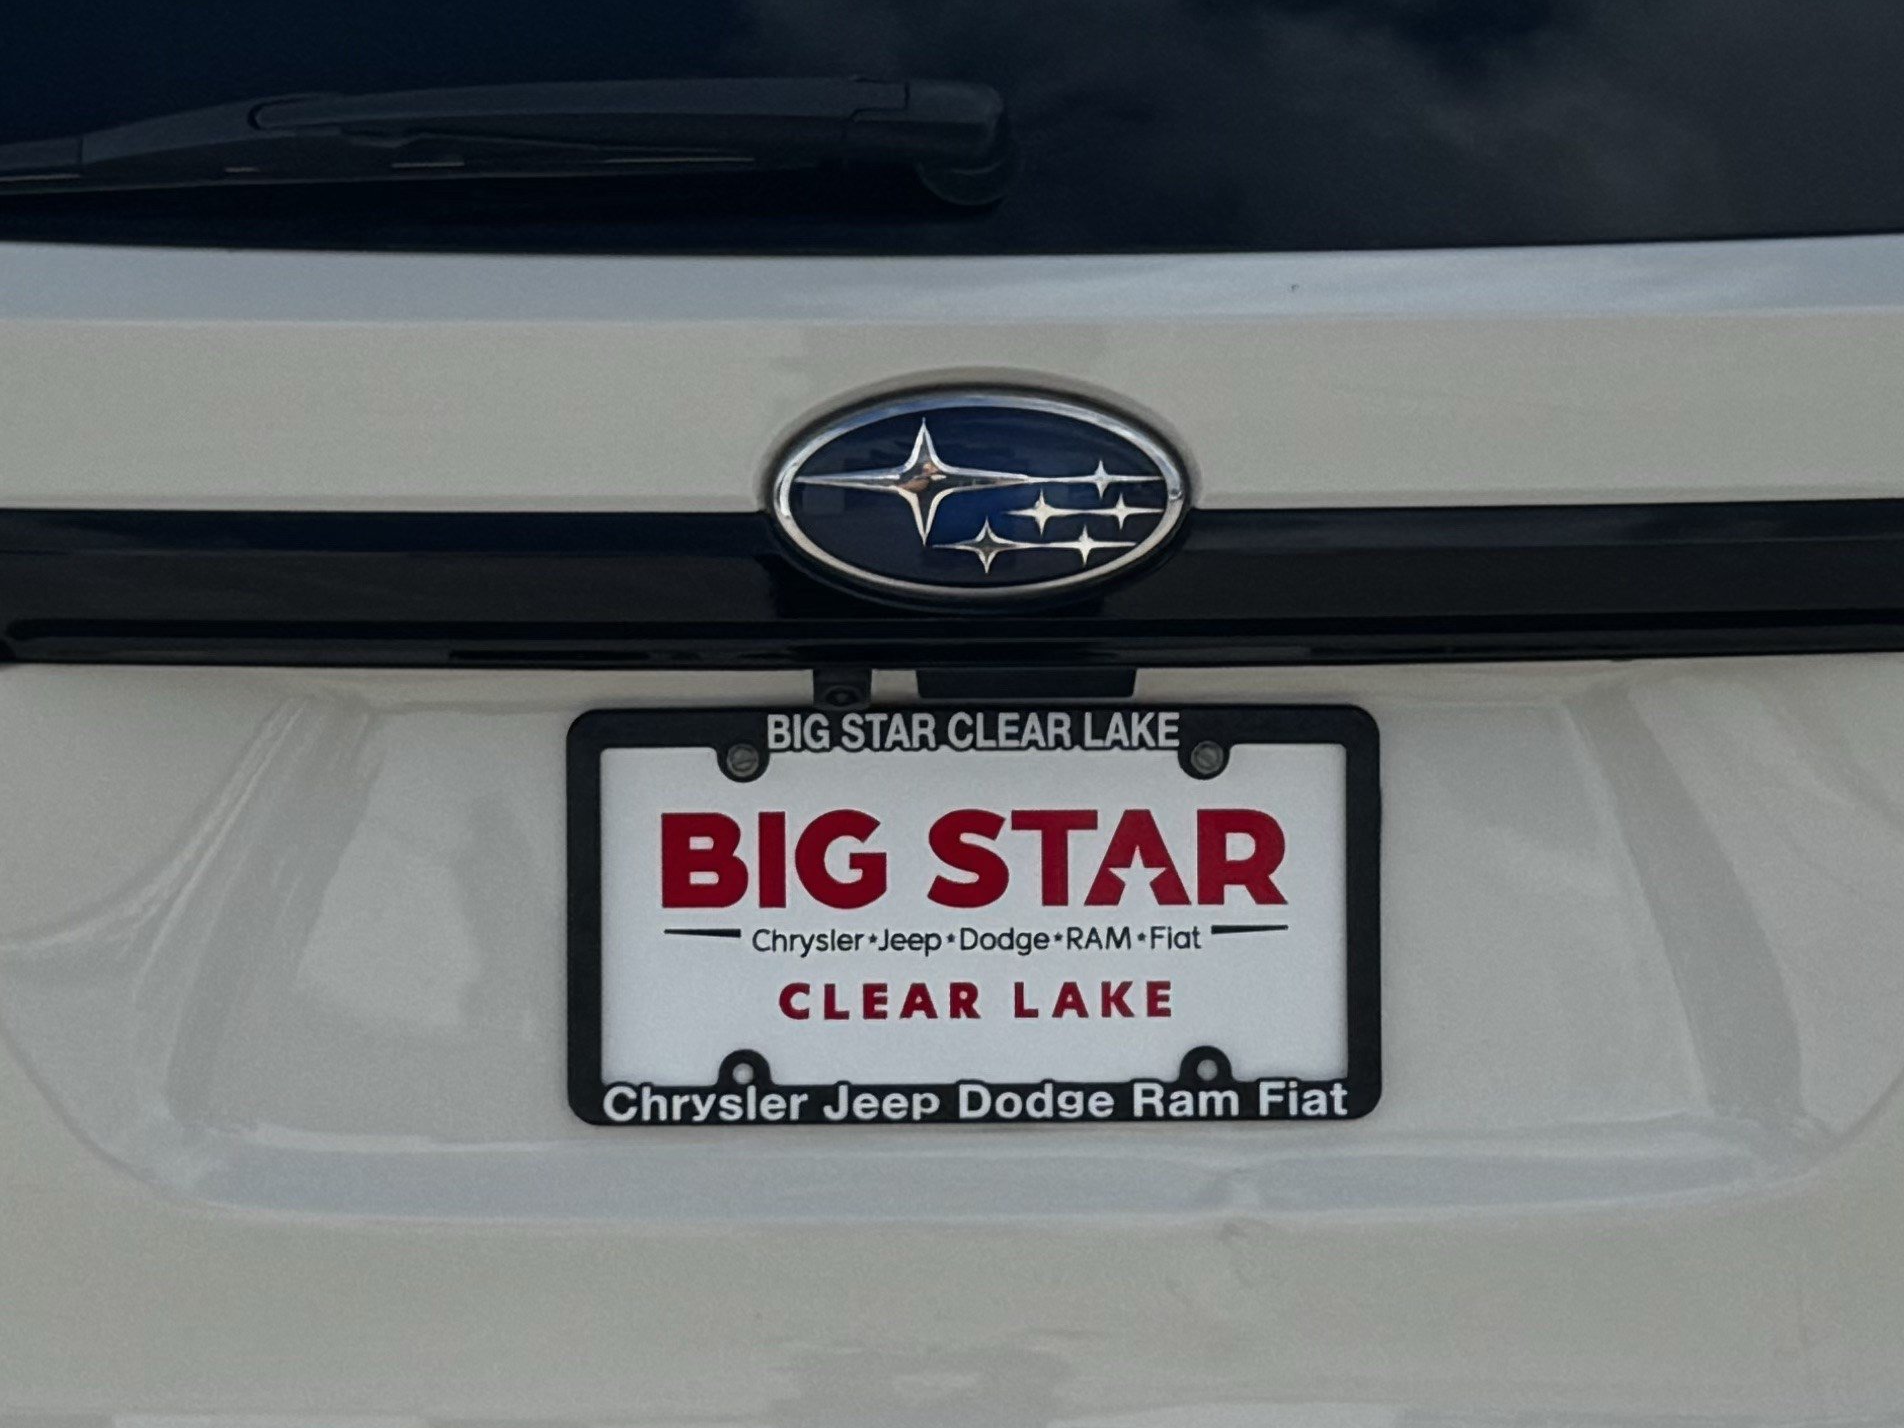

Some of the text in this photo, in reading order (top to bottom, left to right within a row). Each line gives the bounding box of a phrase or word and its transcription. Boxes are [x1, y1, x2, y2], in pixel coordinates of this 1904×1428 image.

[767, 711, 1181, 750] BIG STAR CLEAR LAKE
[660, 808, 1289, 910] BIG STAR
[751, 925, 1203, 959] Chrysler Jeep Dodge RAM Fiat
[778, 980, 1173, 1021] CLEAR LAKE
[601, 1080, 1349, 1122] Chrysler Jeep Dodge Ram Fiat
